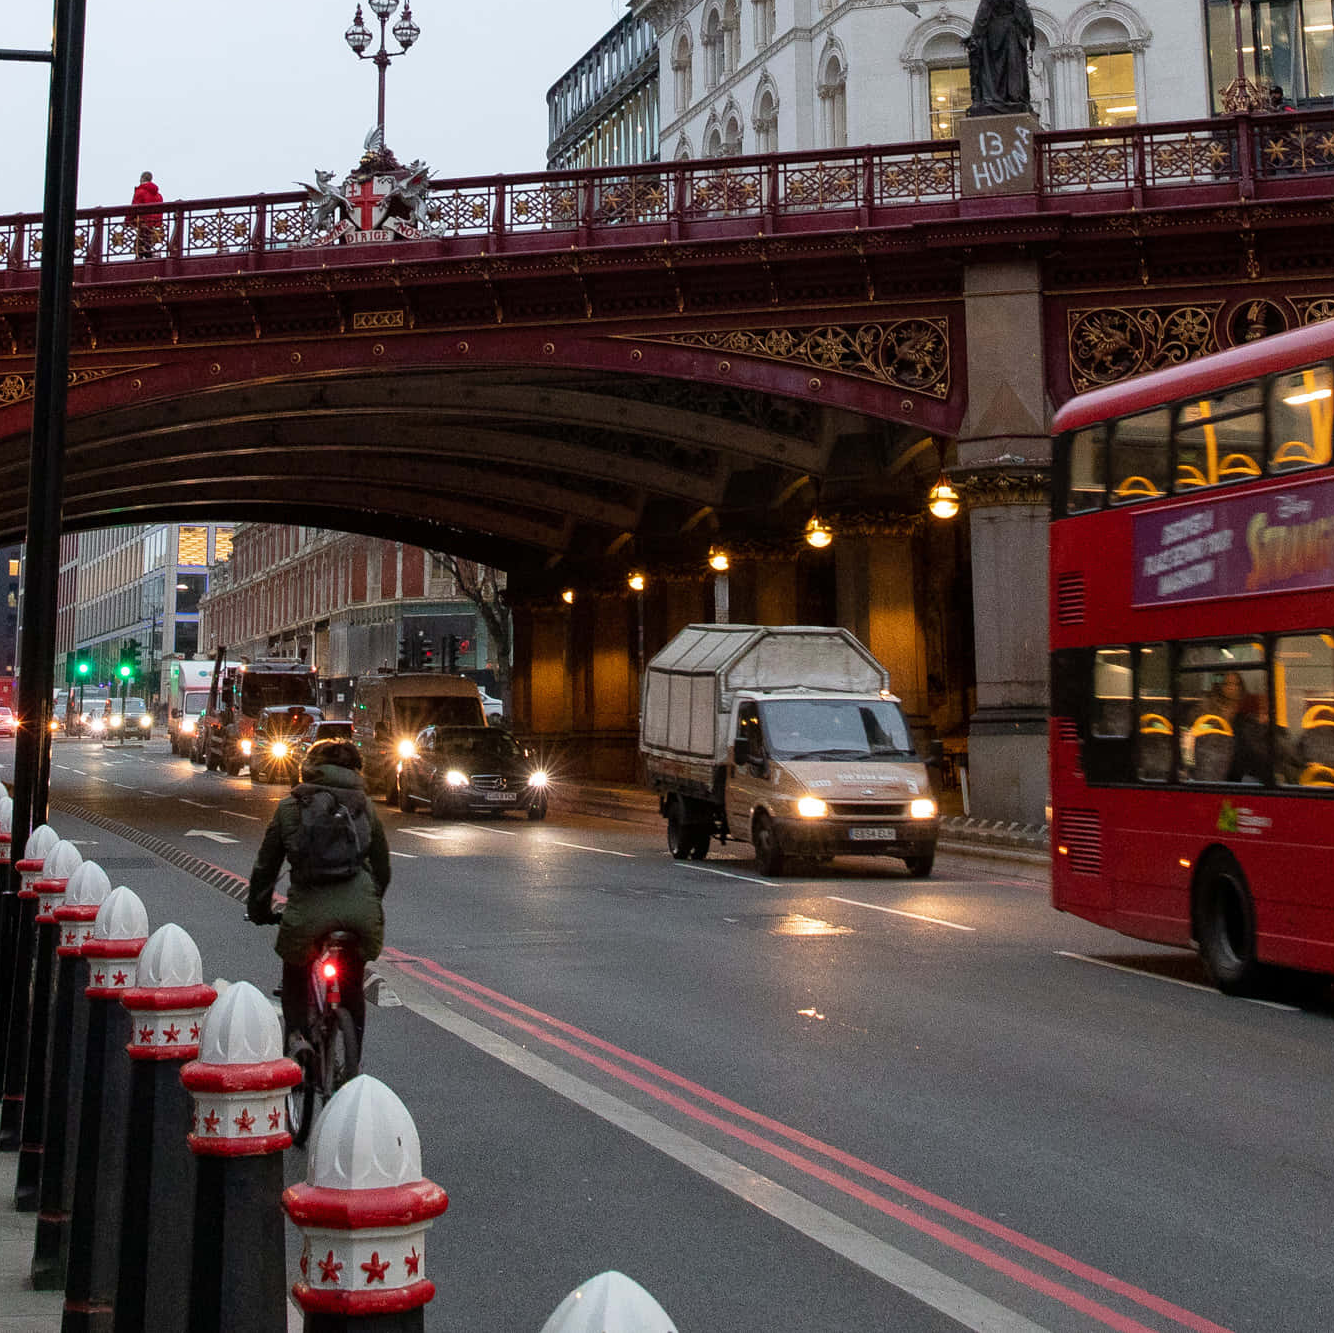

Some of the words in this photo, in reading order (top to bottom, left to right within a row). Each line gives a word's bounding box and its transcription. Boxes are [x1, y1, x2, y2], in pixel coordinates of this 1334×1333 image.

[979, 131, 1004, 157] 13
[972, 125, 1030, 190] HUNNA
[346, 231, 389, 244] DIRIGE
[396, 222, 422, 241] NOS
